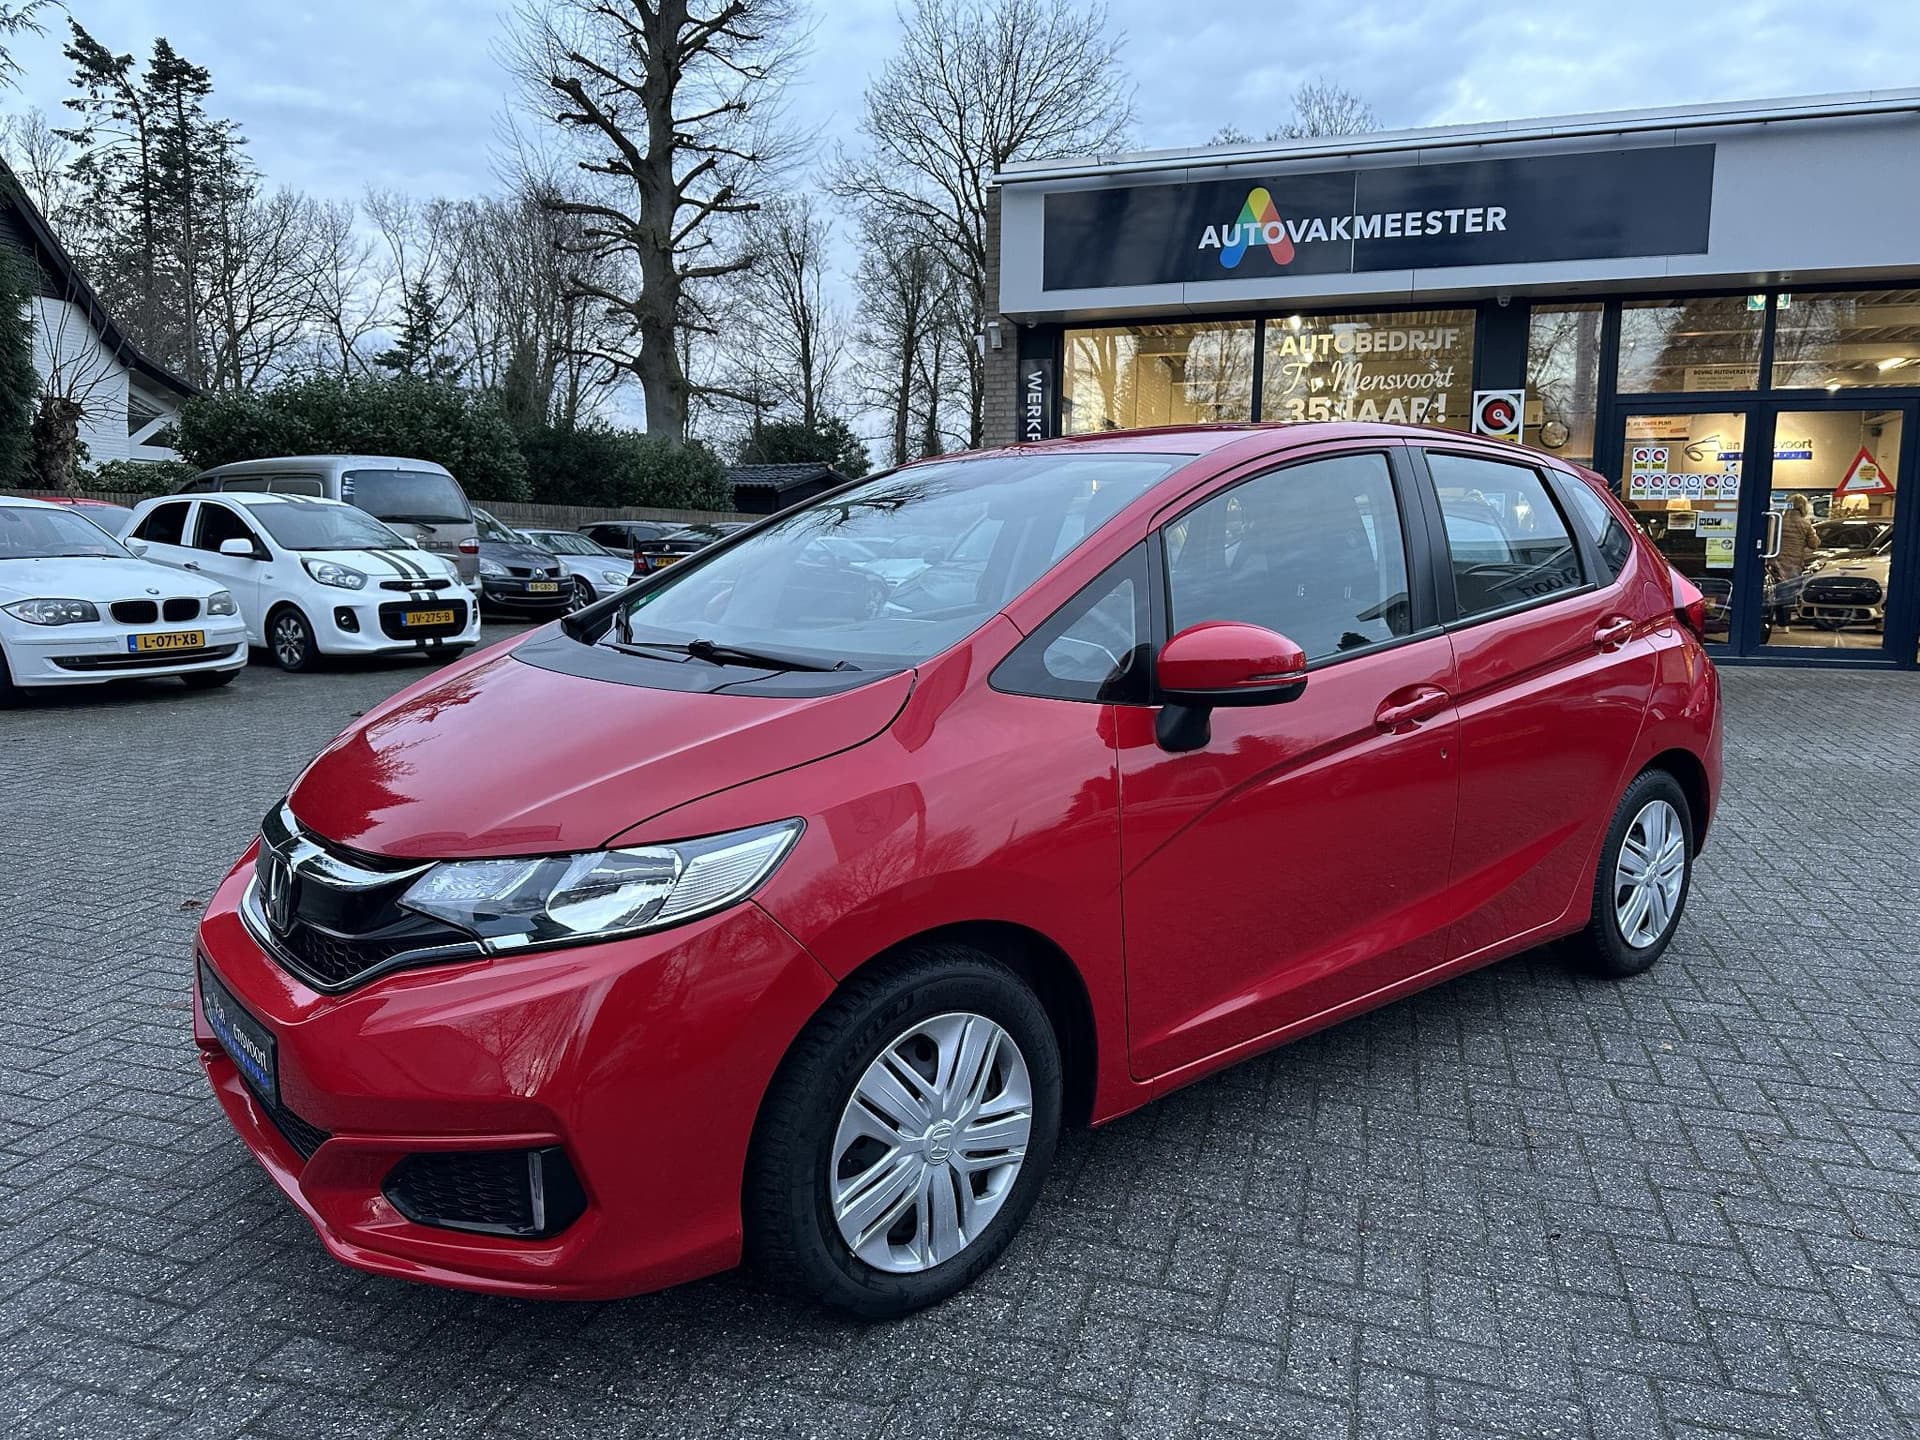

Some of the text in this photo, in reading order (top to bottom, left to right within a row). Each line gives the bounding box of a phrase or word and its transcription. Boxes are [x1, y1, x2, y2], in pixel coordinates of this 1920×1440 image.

[1198, 206, 1507, 249] AUTOVAKMEESTER
[1280, 328, 1460, 357] AUTOBEDRIJF
[1331, 360, 1455, 392] Mensvoort
[1285, 397, 1330, 422] 35
[411, 612, 450, 624] JV-275-B
[143, 633, 198, 649] L-071-XB
